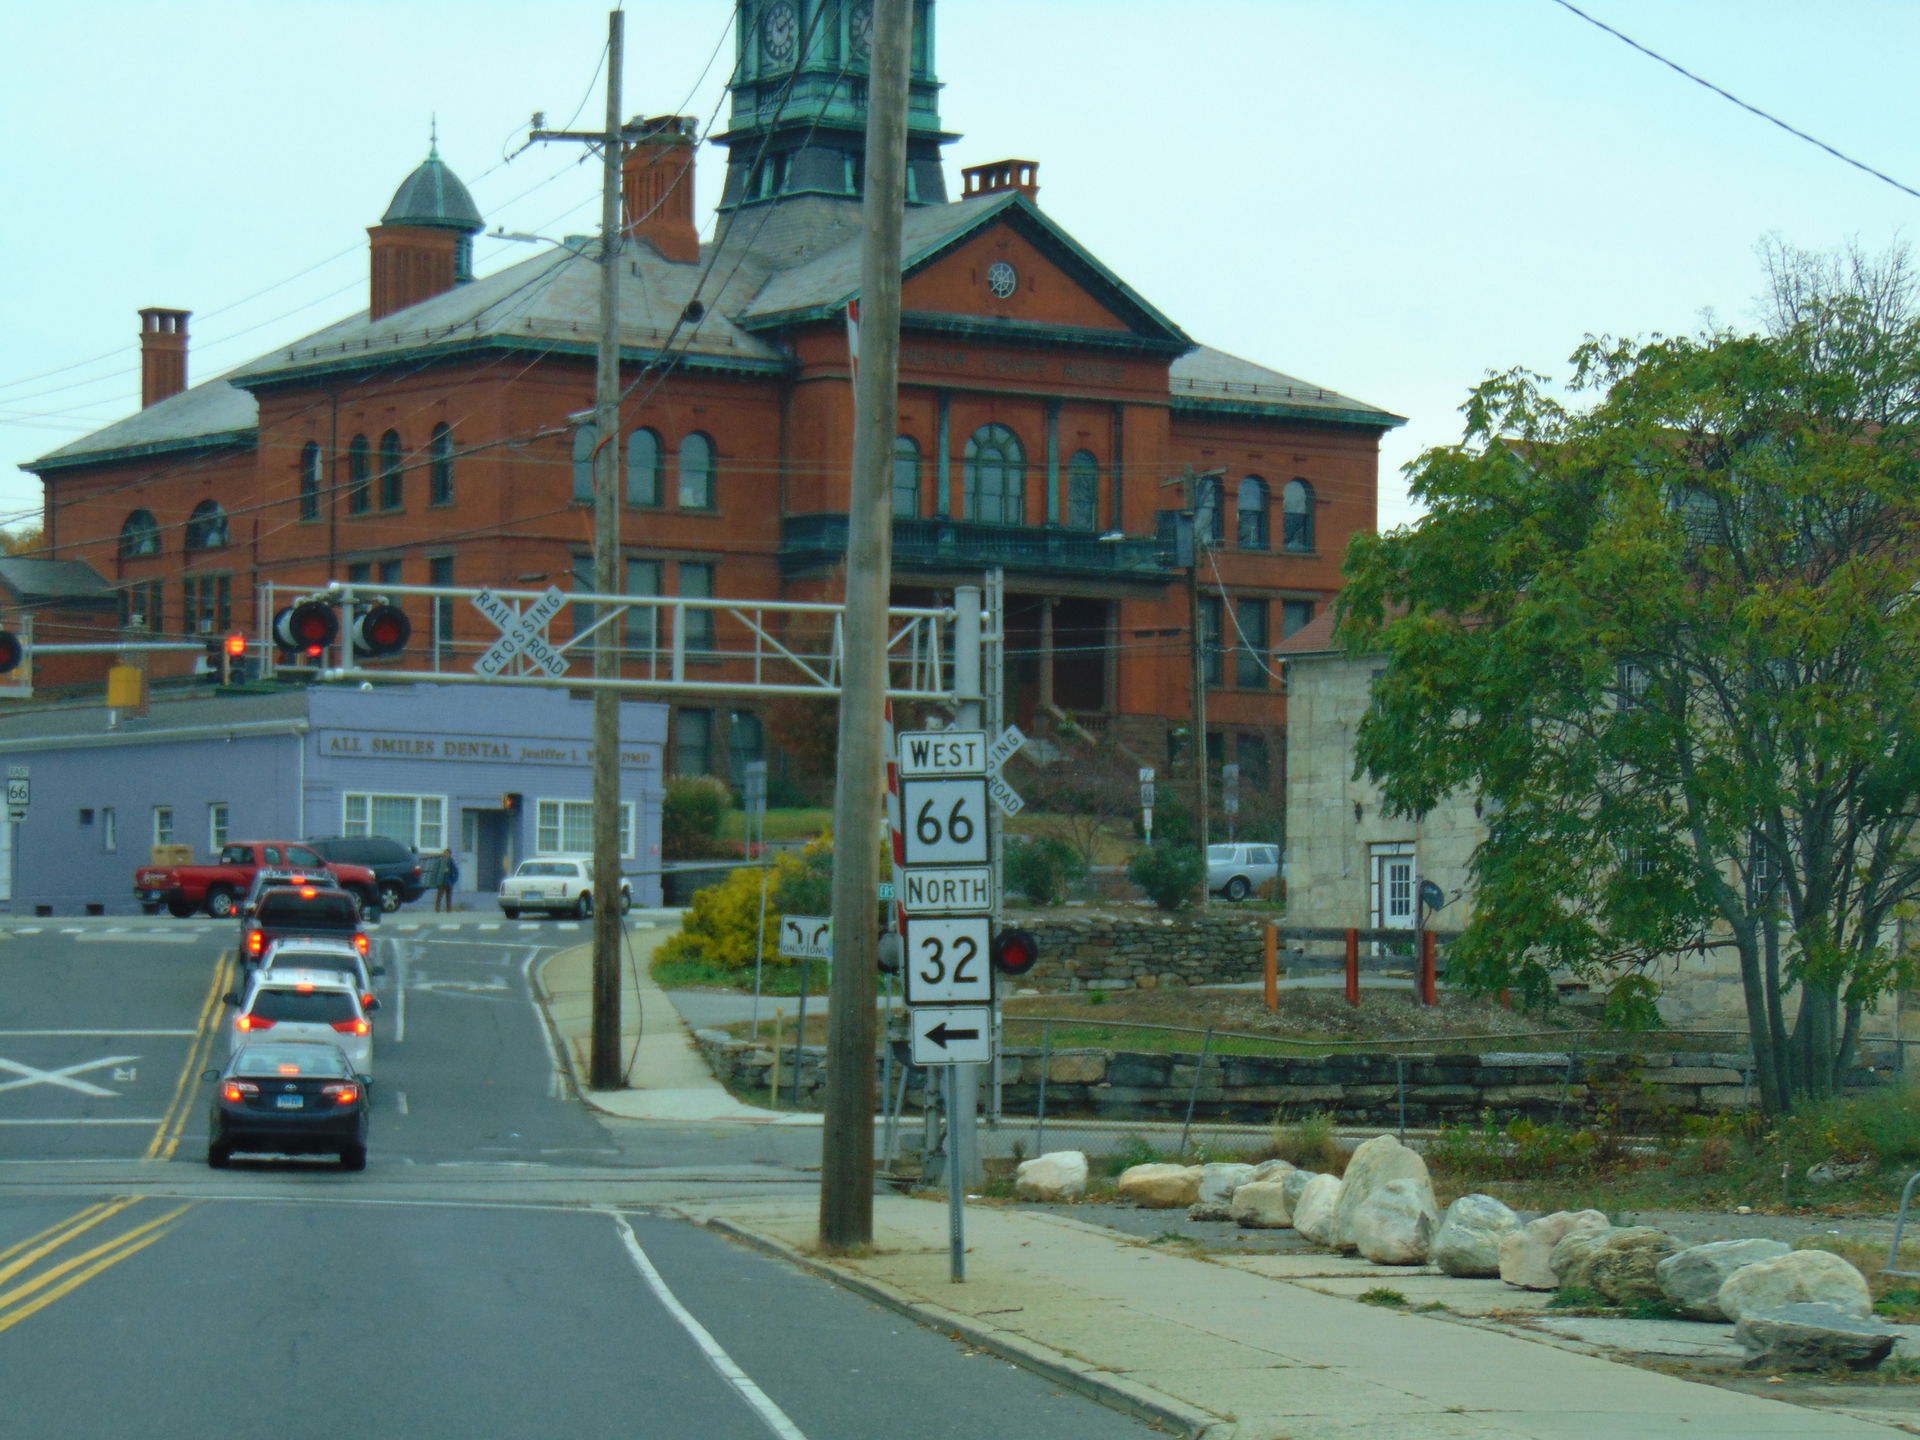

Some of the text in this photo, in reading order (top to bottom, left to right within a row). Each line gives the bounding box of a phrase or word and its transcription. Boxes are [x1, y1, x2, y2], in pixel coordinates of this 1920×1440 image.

[476, 591, 564, 674] RAIL ROAD
[481, 594, 560, 673] CROSSING
[330, 736, 361, 751] ALL
[371, 737, 434, 754] SMILES
[443, 741, 512, 758] DENTAL
[910, 740, 976, 768] WEST
[10, 785, 27, 799] 66
[917, 798, 974, 844] 66
[908, 877, 986, 903] NORTH
[783, 944, 805, 954] ONLY
[920, 936, 978, 984] 32
